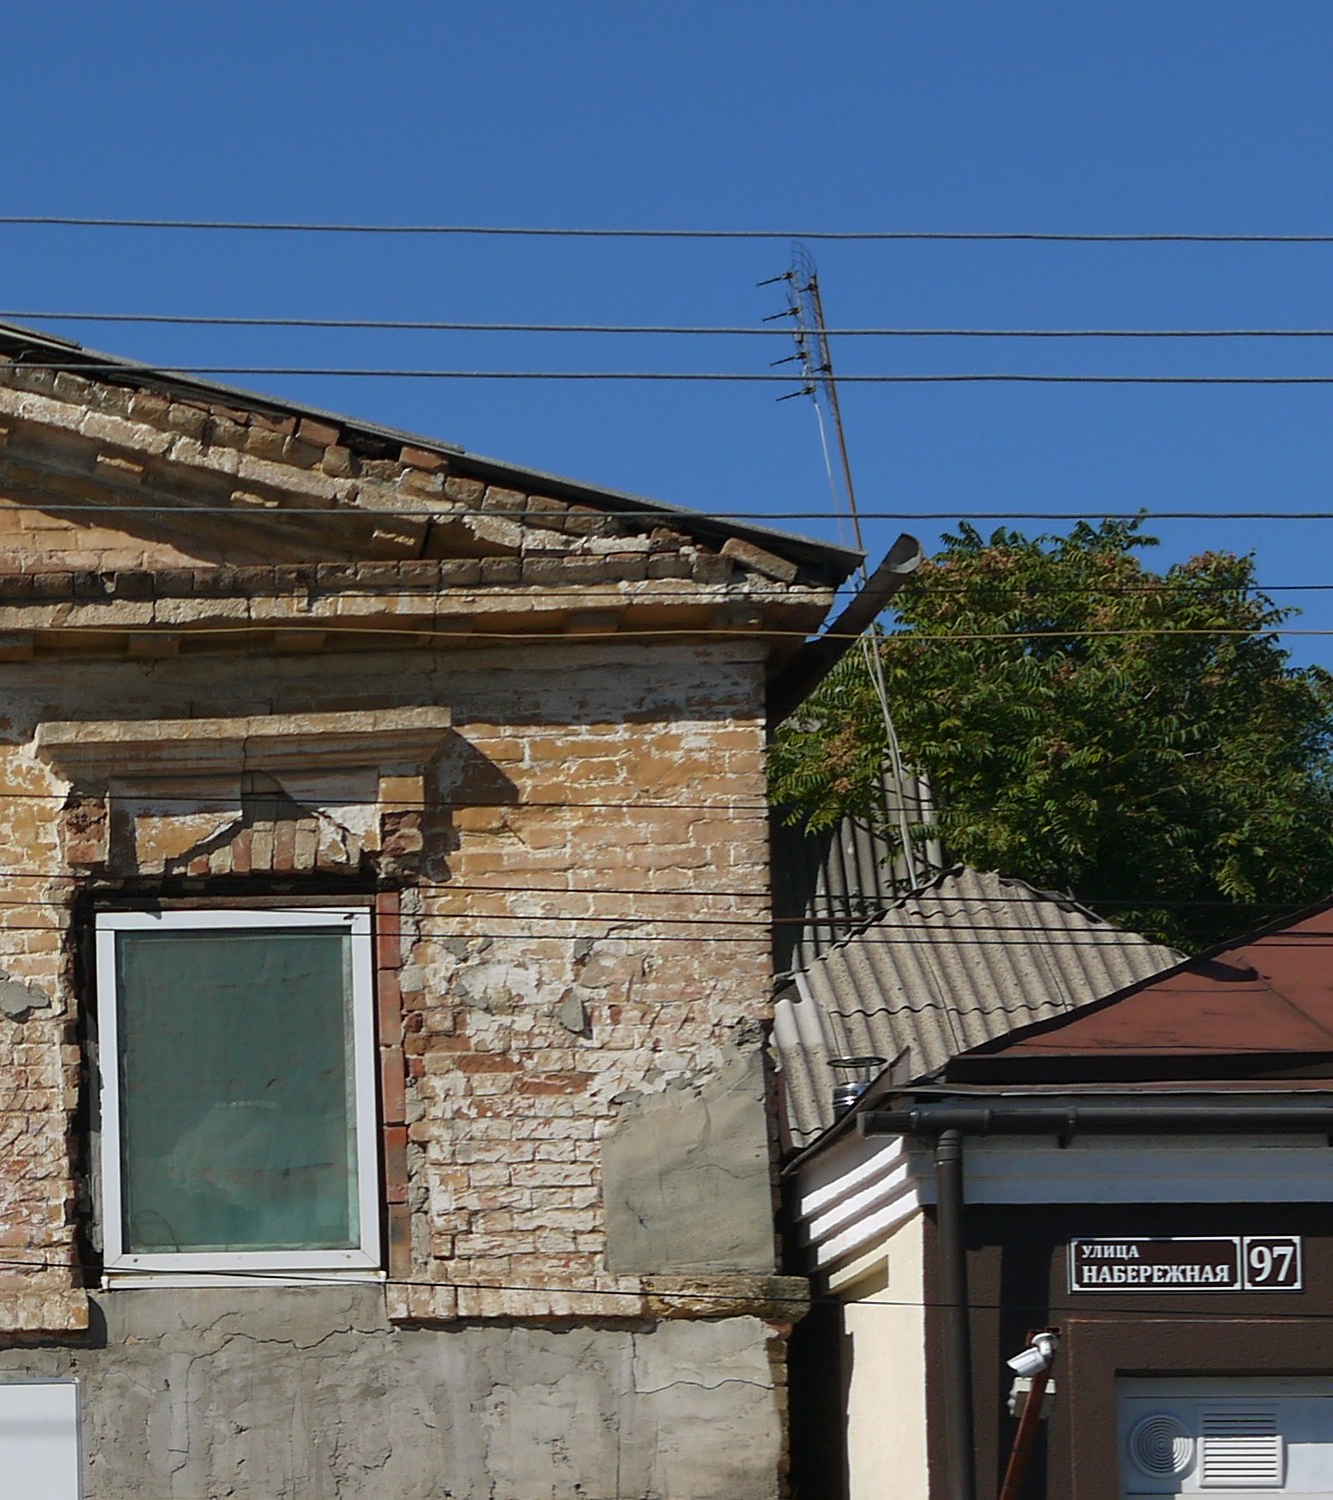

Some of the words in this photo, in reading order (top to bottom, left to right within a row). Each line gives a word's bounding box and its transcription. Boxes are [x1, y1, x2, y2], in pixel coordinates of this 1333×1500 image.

[1082, 1245, 1140, 1261] УЛИЦА
[1082, 1264, 1230, 1284] НАБЕРЕЖНАЯ
[1249, 1246, 1294, 1283] 97
